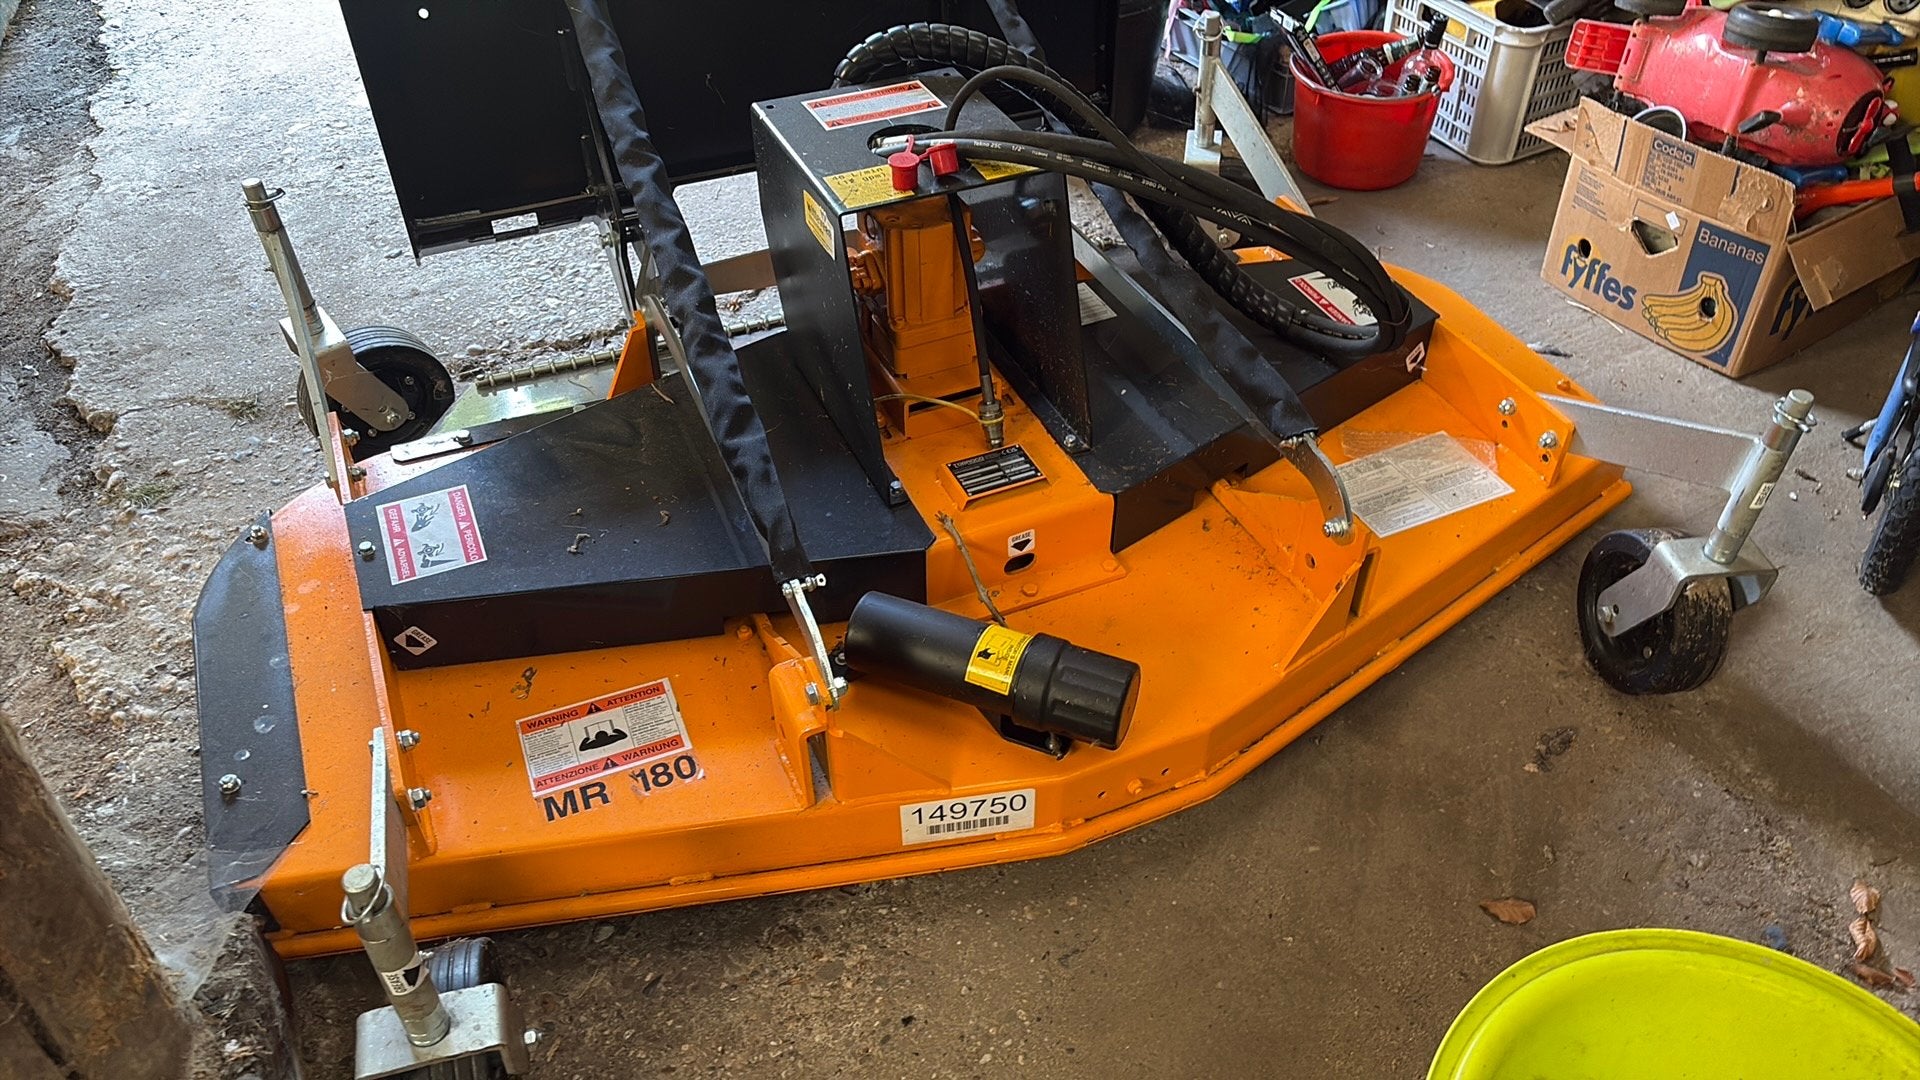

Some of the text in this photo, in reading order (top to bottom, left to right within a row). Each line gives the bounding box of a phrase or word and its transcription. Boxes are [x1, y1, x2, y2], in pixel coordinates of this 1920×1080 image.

[1698, 228, 1766, 265] Bananas
[1561, 244, 1637, 310] fyffes
[388, 508, 401, 533] GEFAHR
[452, 491, 479, 560] DANGER PERICOLO
[1011, 531, 1032, 542] GREASE
[411, 629, 434, 644] GREASE
[526, 686, 661, 730] WARNING ATTENTION
[536, 739, 679, 789] ATTENZIONE WARNUNG
[542, 754, 697, 822] MR 180
[911, 794, 1027, 825] 149750
[386, 972, 407, 993] GREASE
